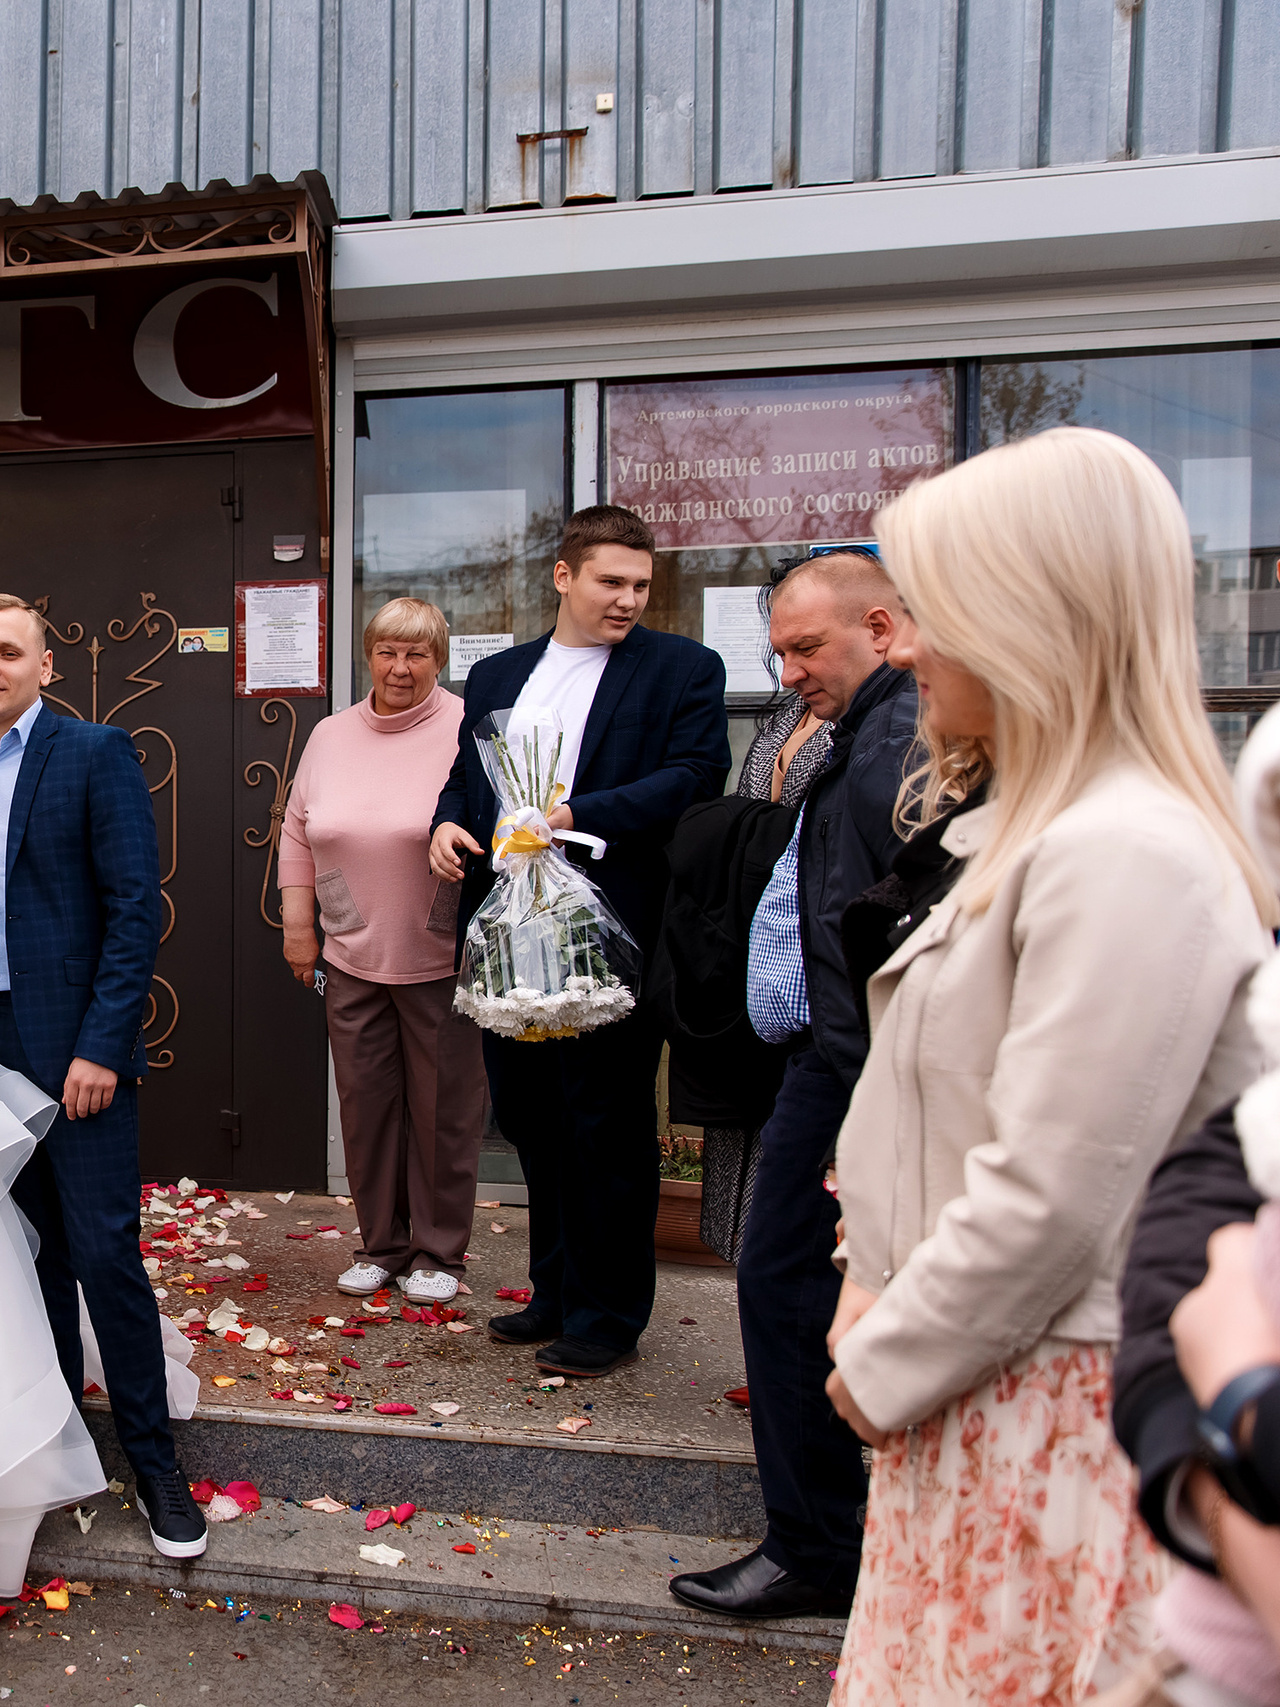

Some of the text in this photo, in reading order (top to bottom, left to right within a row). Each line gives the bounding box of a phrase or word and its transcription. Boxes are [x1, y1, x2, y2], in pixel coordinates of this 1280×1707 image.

[637, 393, 913, 423] Артемовского городского округа
[617, 443, 939, 490] Управление записи актов
[620, 488, 905, 526] ражданского состоян
[459, 636, 504, 645] Внимание!
[461, 653, 493, 661] ЧЕТВЕ
